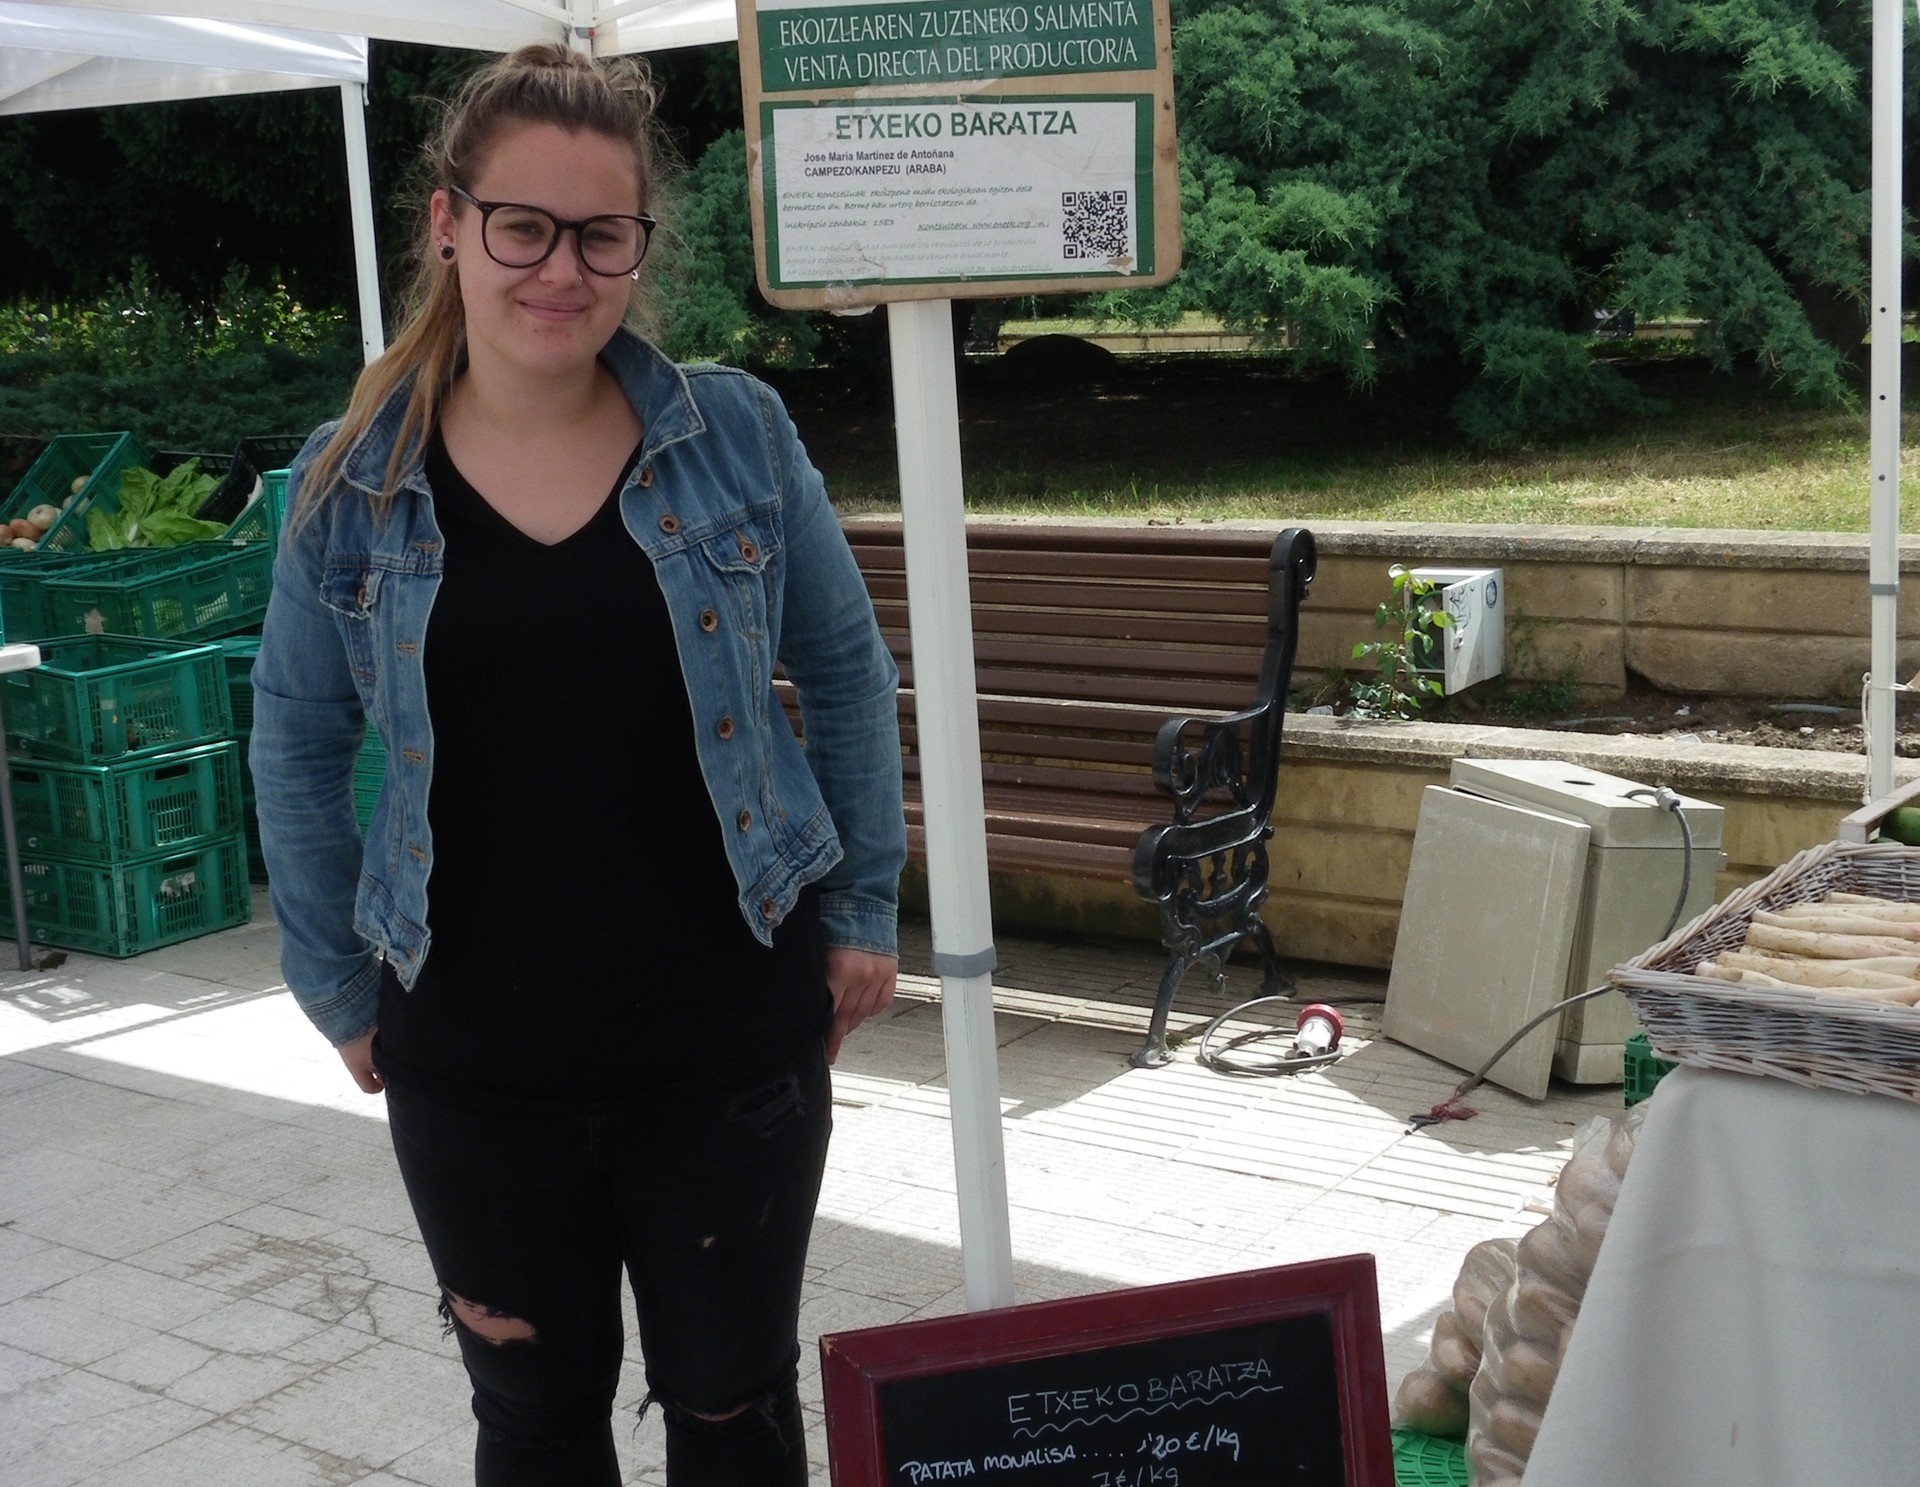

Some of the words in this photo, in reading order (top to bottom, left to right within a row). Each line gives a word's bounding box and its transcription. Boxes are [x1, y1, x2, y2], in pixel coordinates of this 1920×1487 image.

[779, 13, 914, 46] EKOIZLEAREN
[919, 6, 1029, 38] ZUZENEKO
[1034, 1, 1138, 32] SALMENTA
[784, 54, 852, 82] VENTA
[857, 49, 941, 79] DIRECTA
[947, 46, 983, 73] DEL
[989, 37, 1138, 71] PRODUCTOR/A
[835, 112, 942, 140] ETXEKO
[951, 110, 1077, 137] BARATZA
[804, 152, 827, 162] Jose
[897, 149, 909, 160] de
[910, 149, 954, 160] Antoñana
[804, 165, 901, 177] CAMPEZO/KANPEZU
[905, 164, 947, 176] (ARABA)
[1008, 1384, 1140, 1423] ETXEKO
[1147, 1358, 1272, 1402] BARATZA
[899, 1458, 976, 1485] PATATA
